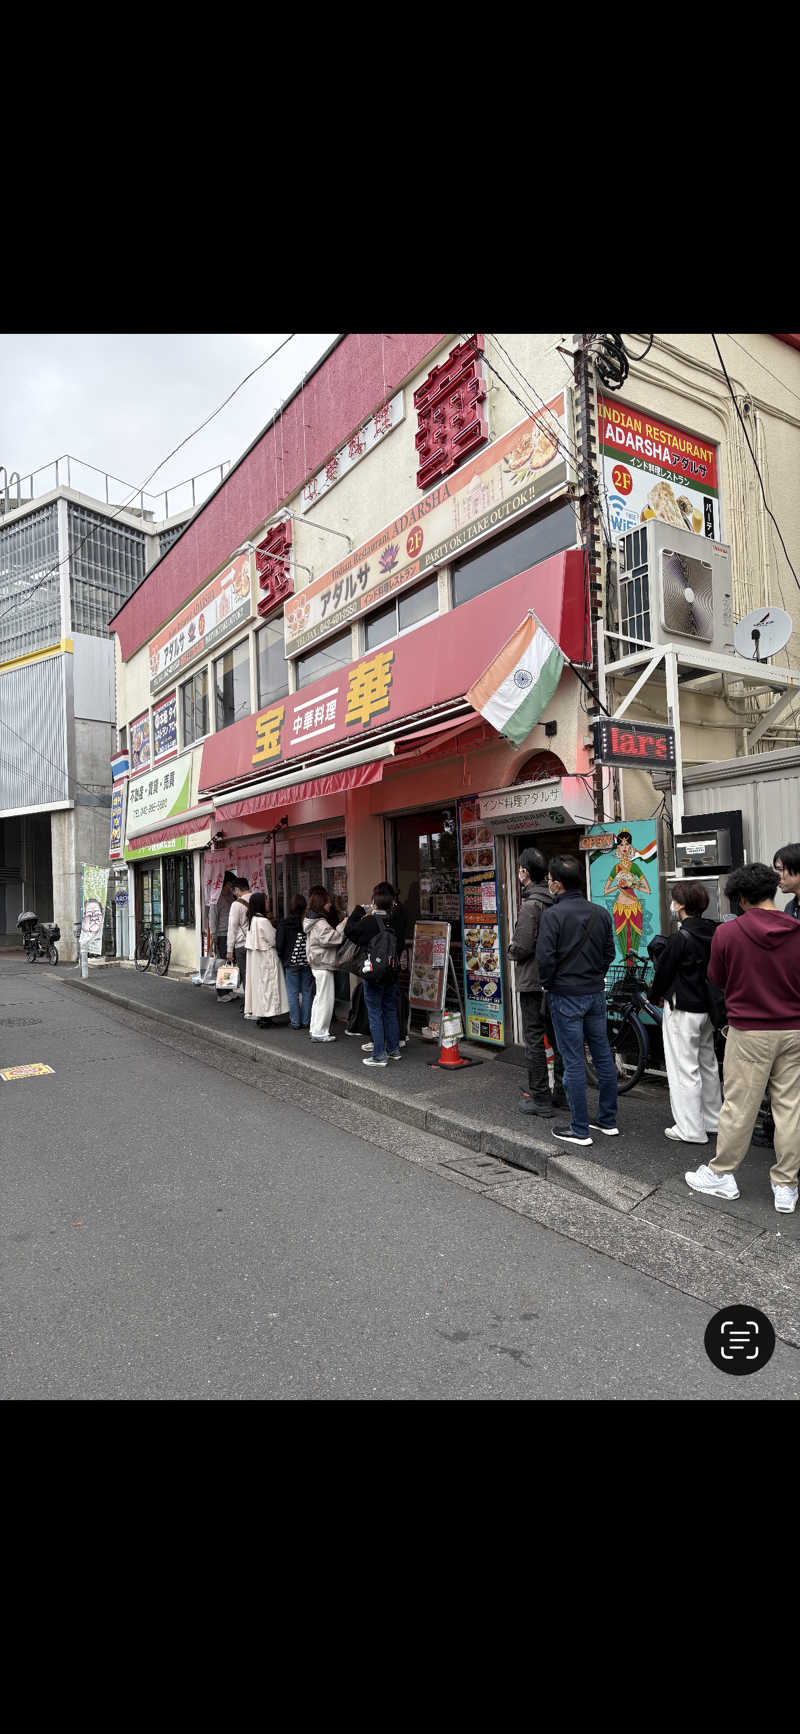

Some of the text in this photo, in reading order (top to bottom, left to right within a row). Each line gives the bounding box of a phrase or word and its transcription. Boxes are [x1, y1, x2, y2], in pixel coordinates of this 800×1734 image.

[414, 334, 488, 490] 華
[597, 403, 713, 463] INDIAN RESTAURANT
[605, 424, 672, 464] ADARSHA
[629, 458, 690, 486] インド料理レストラン
[613, 470, 632, 490] 2F
[392, 483, 451, 539] ADARSHA
[424, 544, 451, 566] PARTY
[467, 519, 490, 541] TAKE
[490, 505, 511, 524] OUT
[407, 530, 422, 554] 2F
[320, 562, 371, 618] アダルサ
[251, 650, 395, 767] 宝 中華料理 華
[581, 833, 611, 849] OPEN
